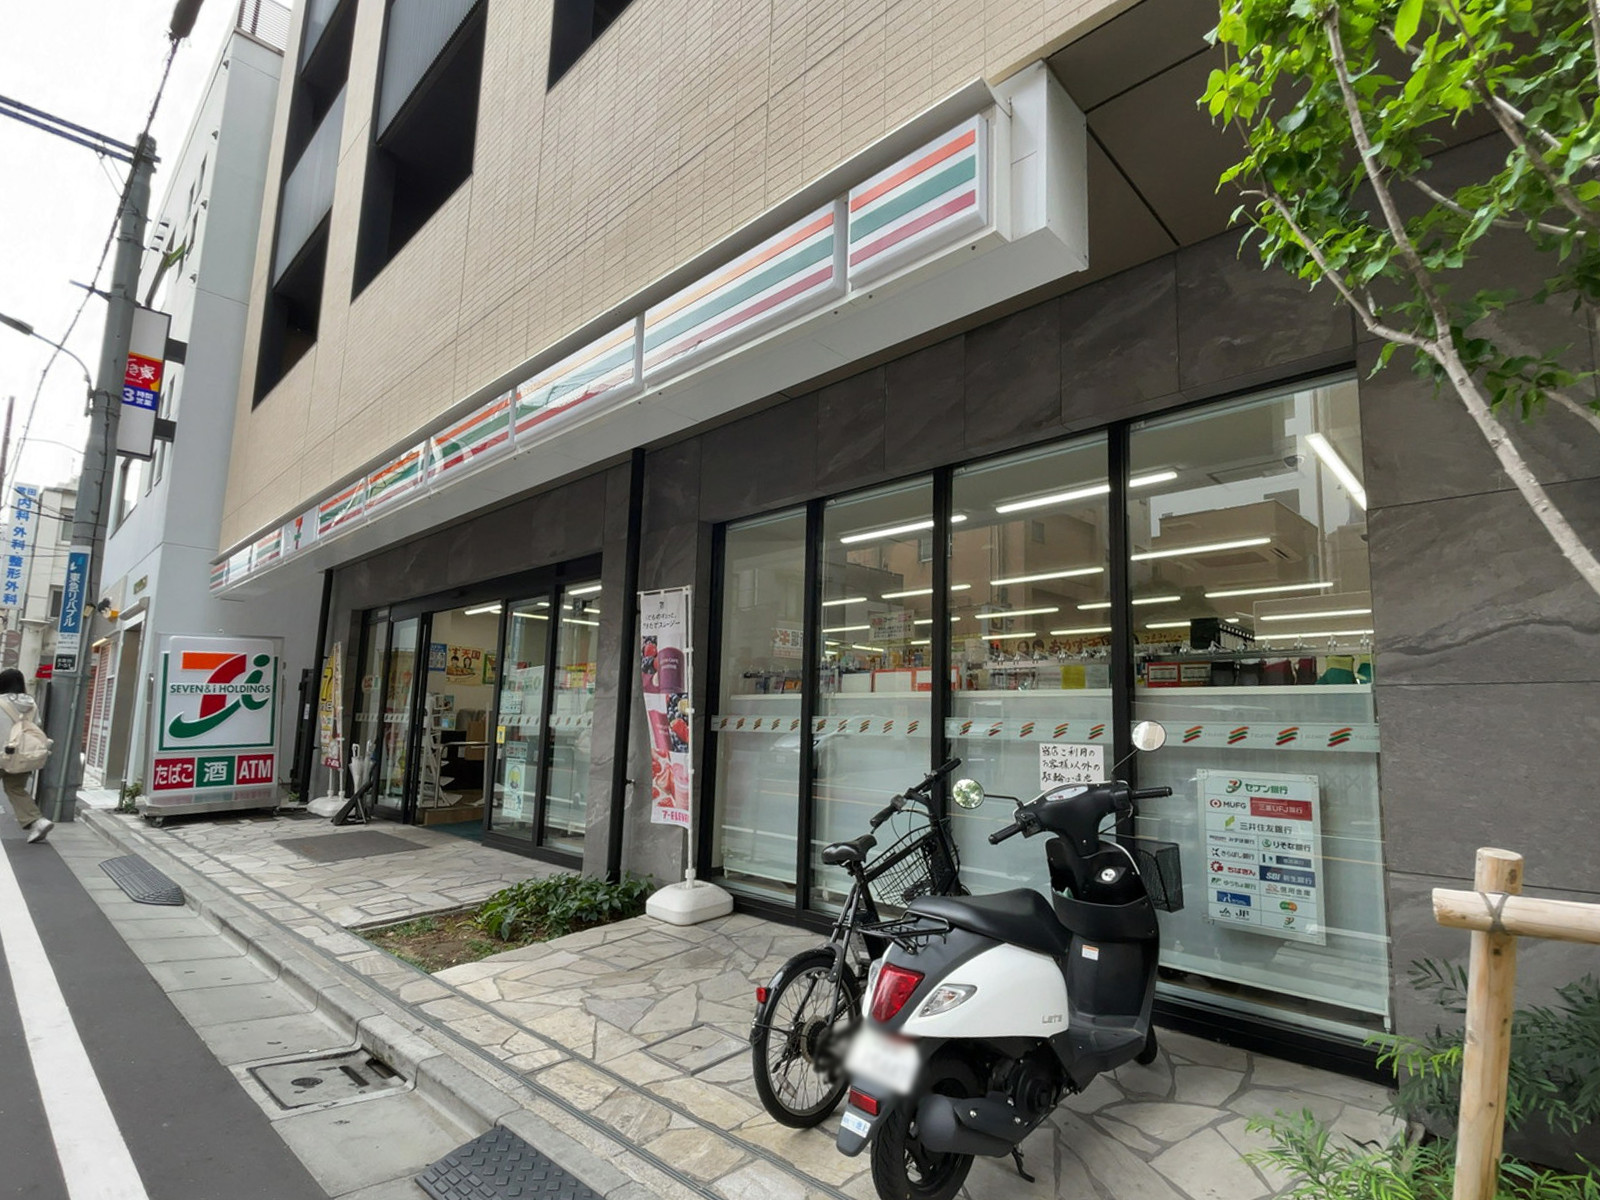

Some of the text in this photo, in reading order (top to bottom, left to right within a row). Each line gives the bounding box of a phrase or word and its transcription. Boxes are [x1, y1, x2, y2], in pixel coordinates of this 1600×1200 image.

[63, 573, 81, 627] 東急リバブル
[219, 684, 271, 694] HOLDINGS
[155, 759, 272, 785] たばこ 酒 ATM
[1245, 783, 1288, 795] セブン銀行
[1223, 801, 1247, 809] MUFG
[1240, 822, 1292, 834] 三井住友銀行
[1273, 841, 1311, 852] りそな銀行
